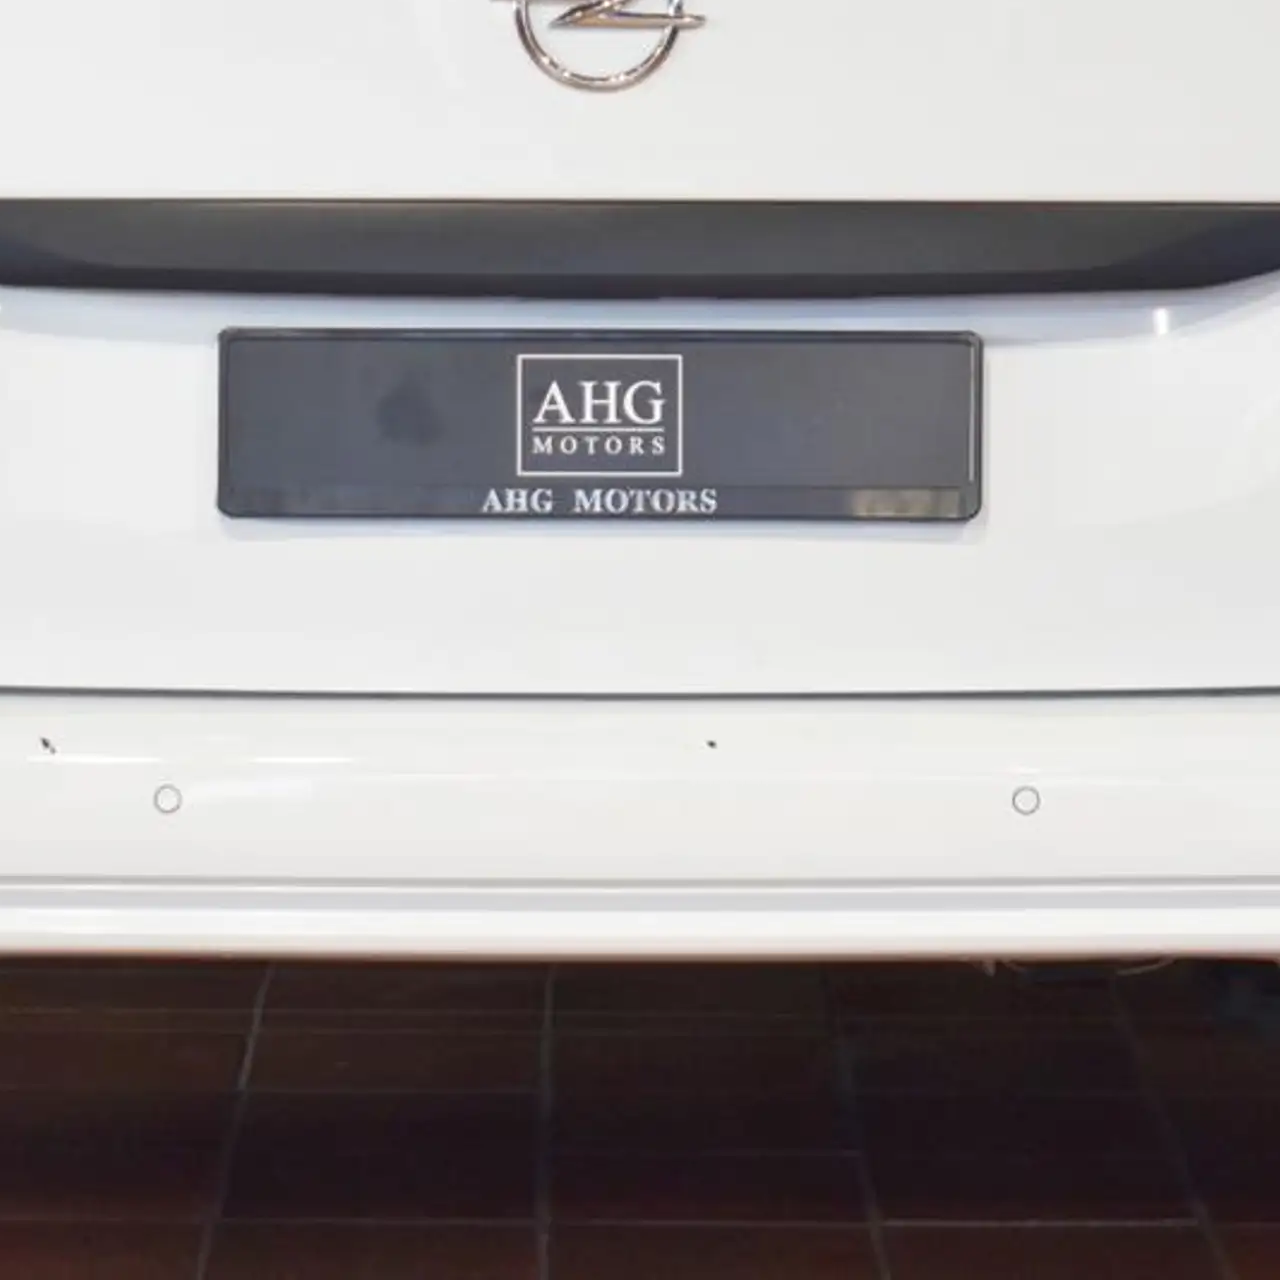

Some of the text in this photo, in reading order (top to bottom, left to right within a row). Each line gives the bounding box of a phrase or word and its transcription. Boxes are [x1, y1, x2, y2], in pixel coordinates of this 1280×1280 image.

[531, 379, 666, 424] AHG
[531, 435, 665, 455] MOTORS
[481, 486, 718, 514] AHG MOTORS
